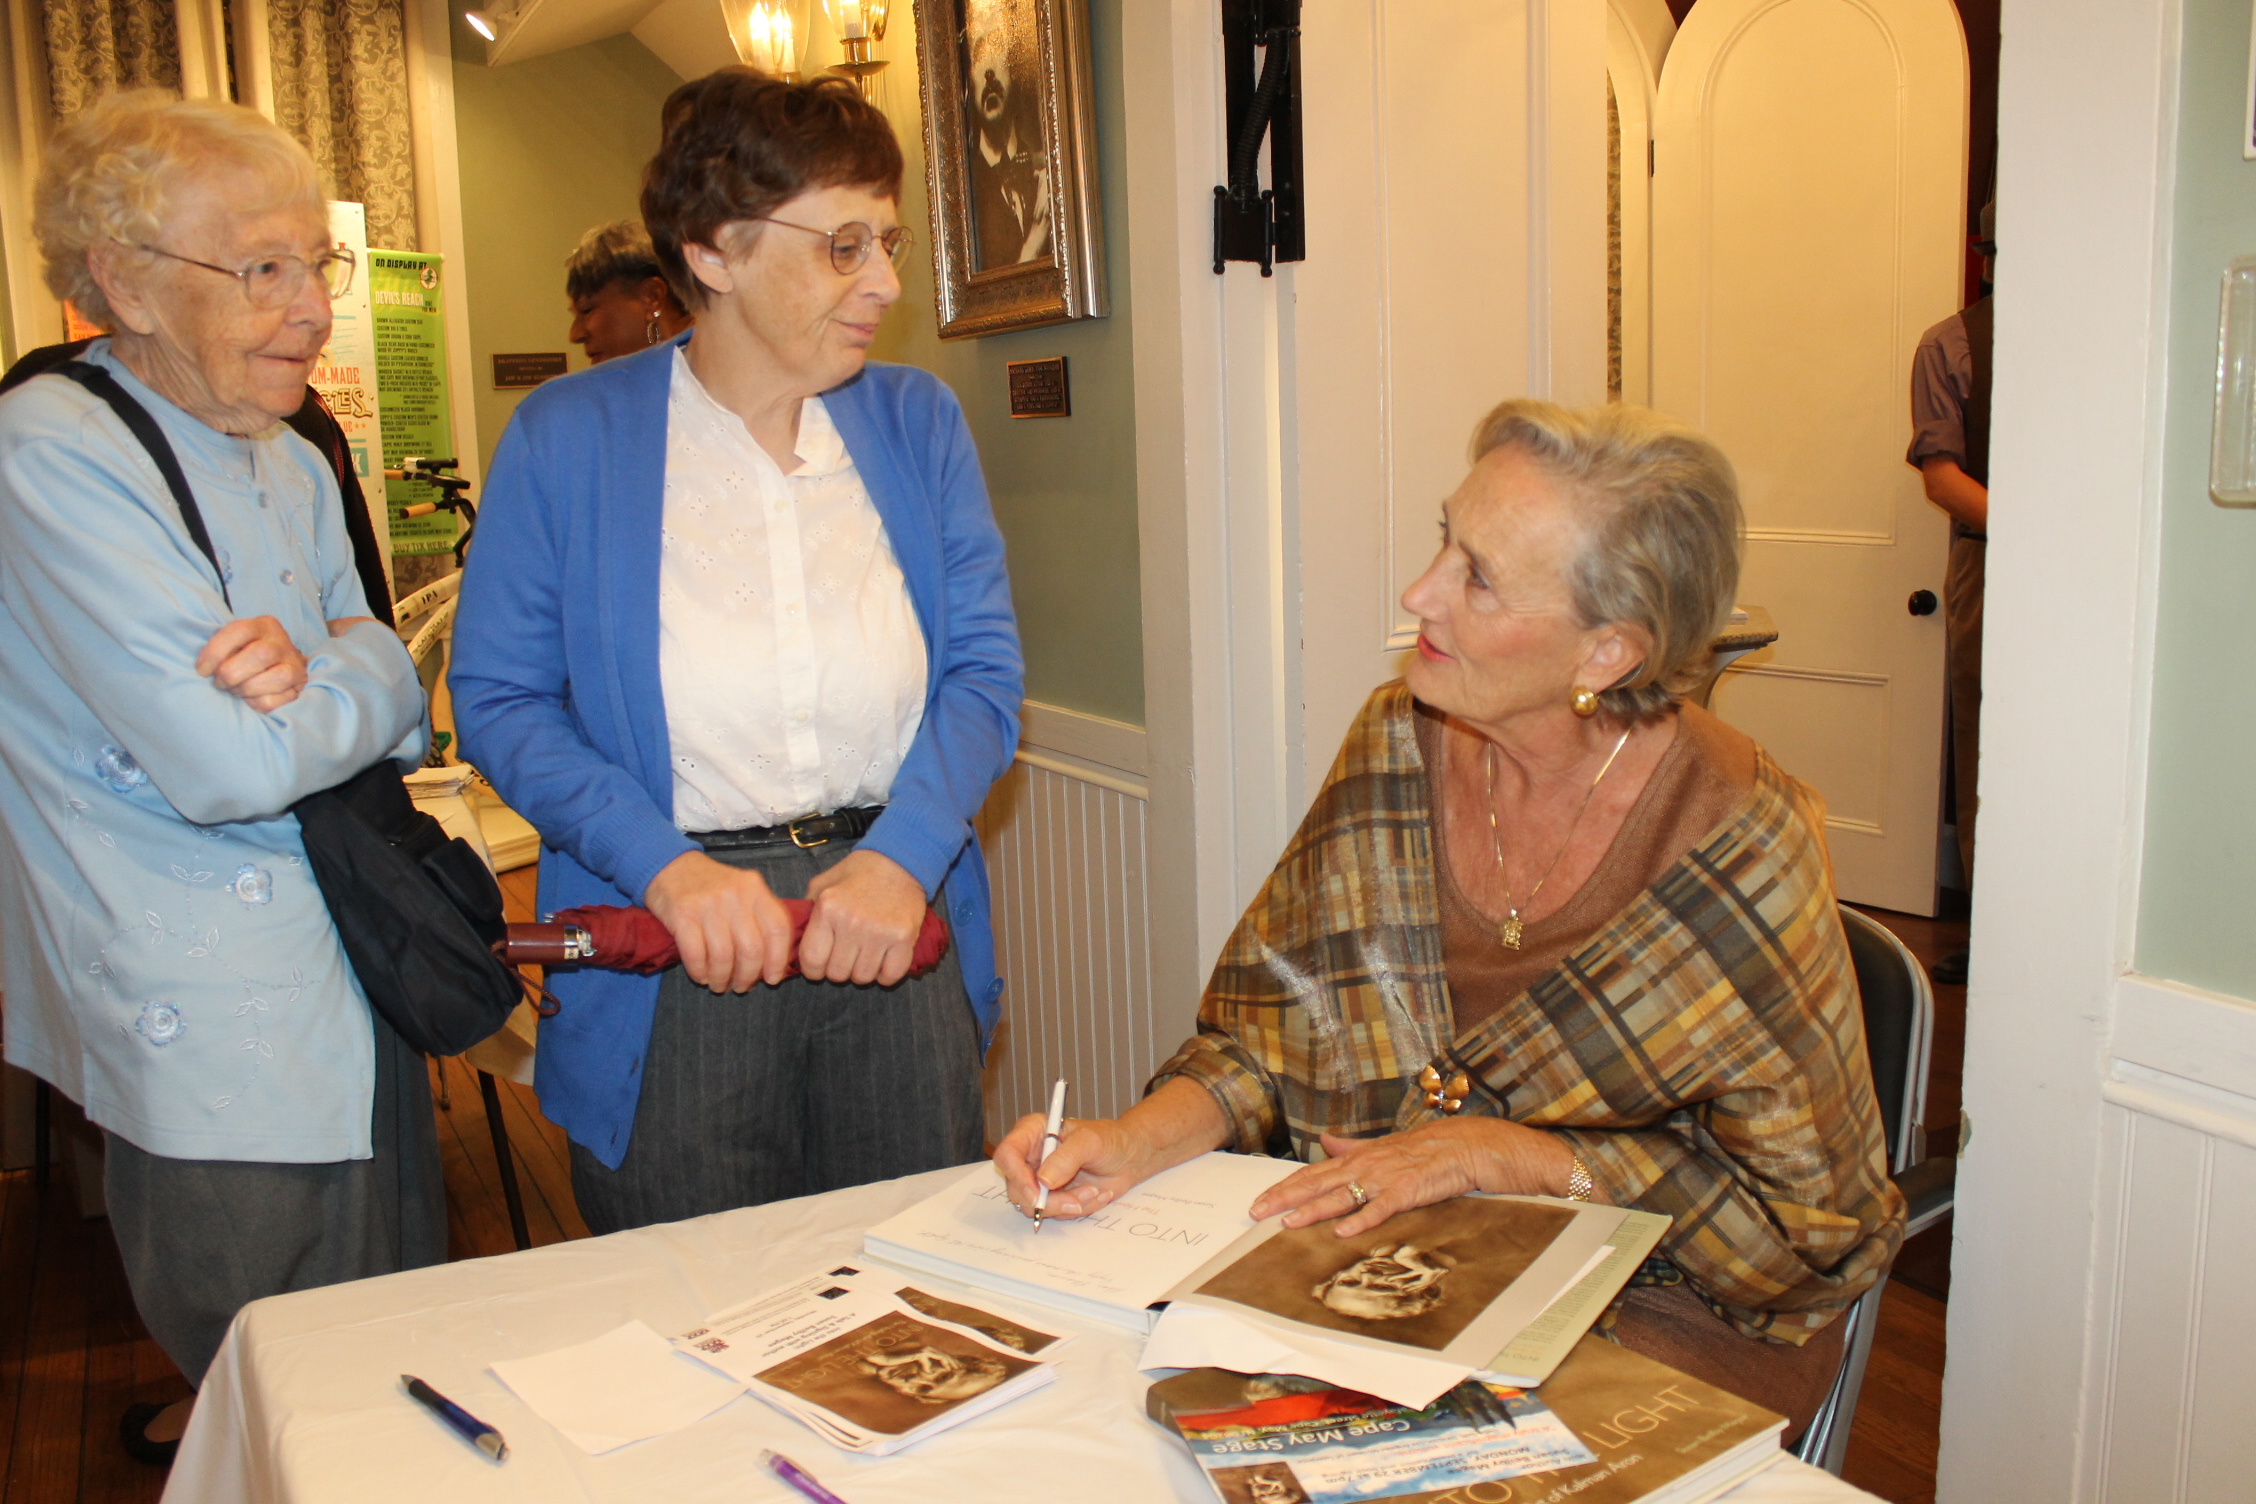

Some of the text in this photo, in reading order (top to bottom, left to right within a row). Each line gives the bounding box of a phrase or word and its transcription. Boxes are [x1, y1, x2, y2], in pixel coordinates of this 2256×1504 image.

[376, 258, 427, 270] ON DISPLAY AT
[375, 291, 424, 306] DEVIL'S REACH
[311, 366, 360, 384] OM-MADE
[321, 387, 373, 418] CLES
[393, 541, 449, 553] BUY TIX HERE
[422, 590, 437, 605] IPA
[1128, 1223, 1208, 1246] INTO
[1582, 1384, 1700, 1449] LIGHT
[1213, 1419, 1411, 1455] Cape May Stage
[1393, 1458, 1467, 1475] SEPTEMBER
[1561, 1468, 1613, 1494] Kalman
[1608, 1453, 1643, 1478] Aron
